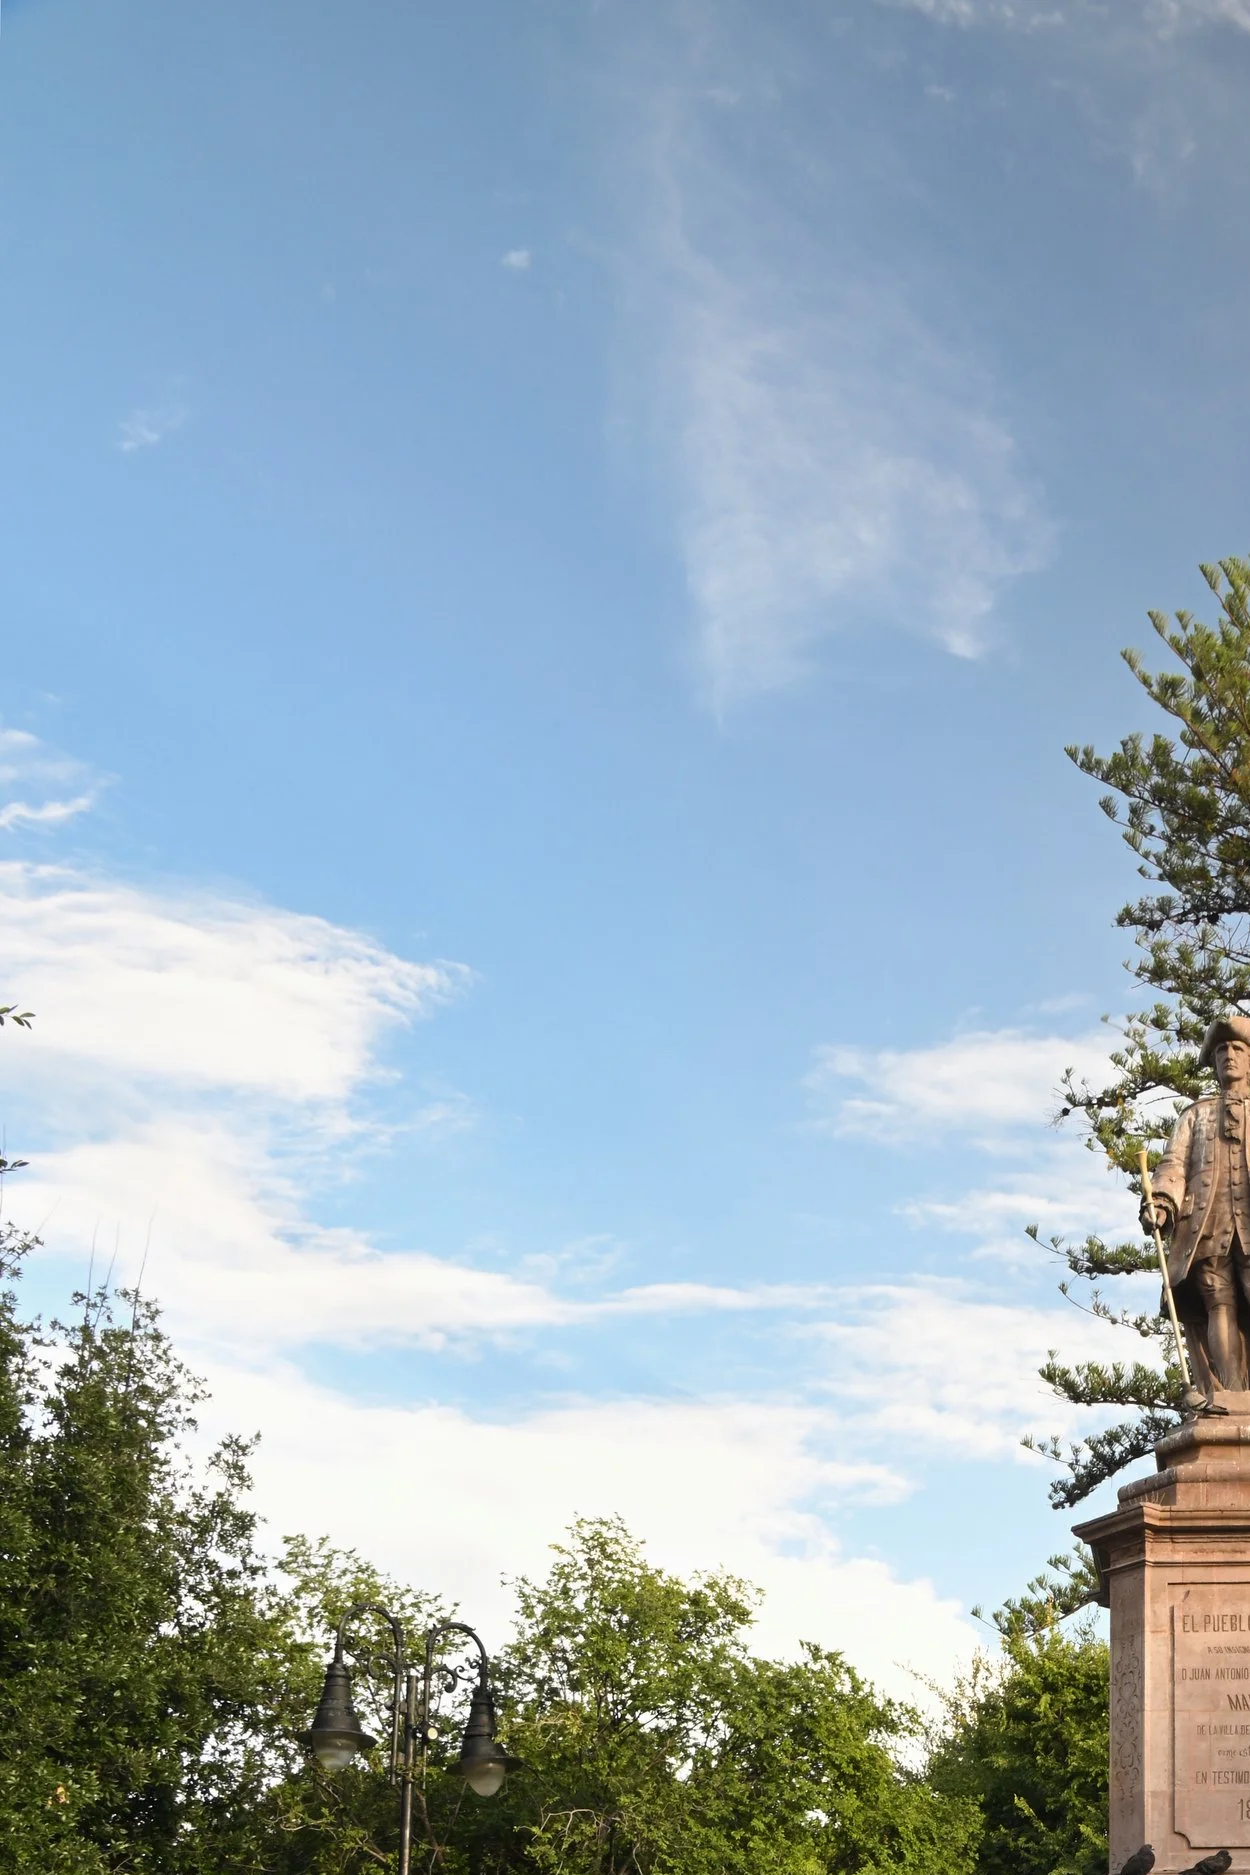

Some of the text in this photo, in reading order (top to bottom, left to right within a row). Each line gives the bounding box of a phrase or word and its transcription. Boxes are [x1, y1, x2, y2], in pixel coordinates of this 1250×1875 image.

[1182, 1614, 1199, 1633] EL
[1189, 1667, 1211, 1680] JUAN
[1215, 1667, 1249, 1680] ANTONIO
[1196, 1724, 1206, 1736] DE
[1208, 1724, 1218, 1736] LA
[1219, 1724, 1239, 1736] VILLA
[1195, 1771, 1208, 1784] EN
